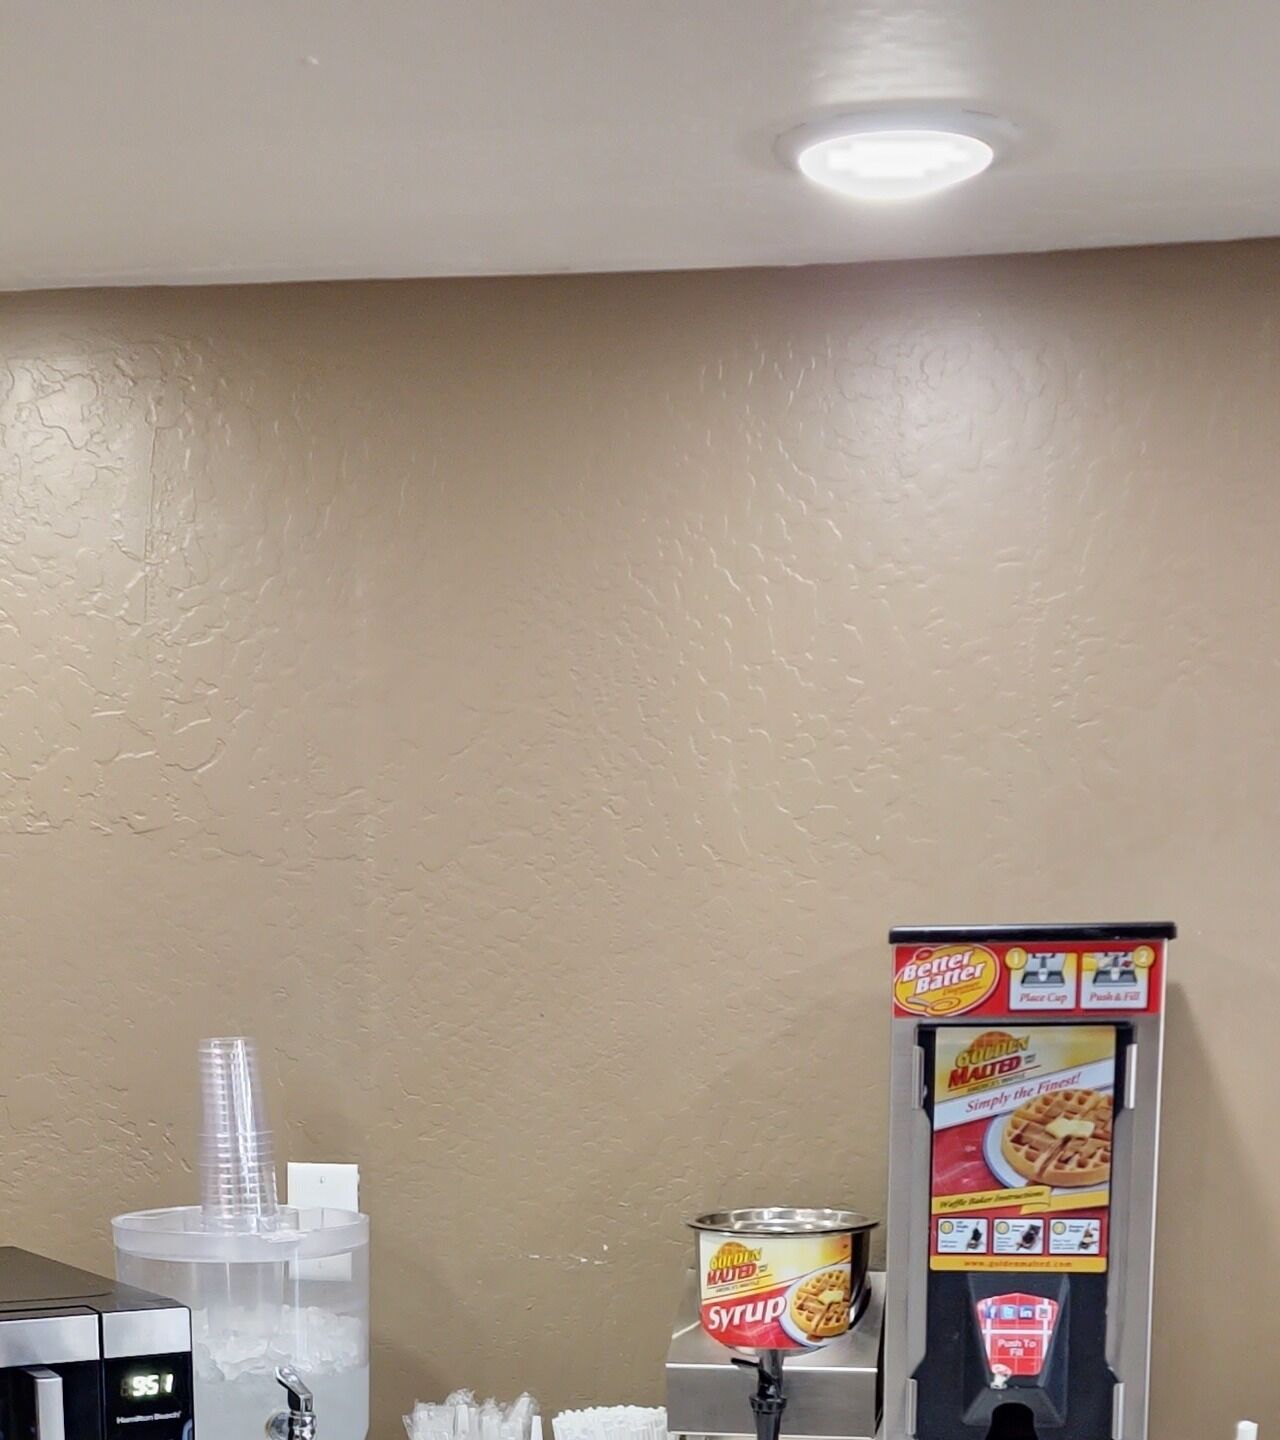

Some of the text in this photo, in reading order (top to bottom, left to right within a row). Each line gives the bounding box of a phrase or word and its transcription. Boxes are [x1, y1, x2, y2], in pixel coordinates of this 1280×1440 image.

[902, 950, 975, 982] Better
[915, 962, 986, 995] Batter
[1019, 993, 1068, 1005] Place Cup
[1089, 992, 1111, 1001] Push
[1124, 991, 1141, 1001] Fill
[955, 1035, 1030, 1068] GOLDEN
[948, 1055, 1022, 1088] MALTED
[965, 1091, 1011, 1113] Simply
[1013, 1085, 1033, 1100] the
[1037, 1072, 1081, 1095] Finest!
[710, 1247, 762, 1271] GOLDEN
[708, 1296, 786, 1332] Syrup
